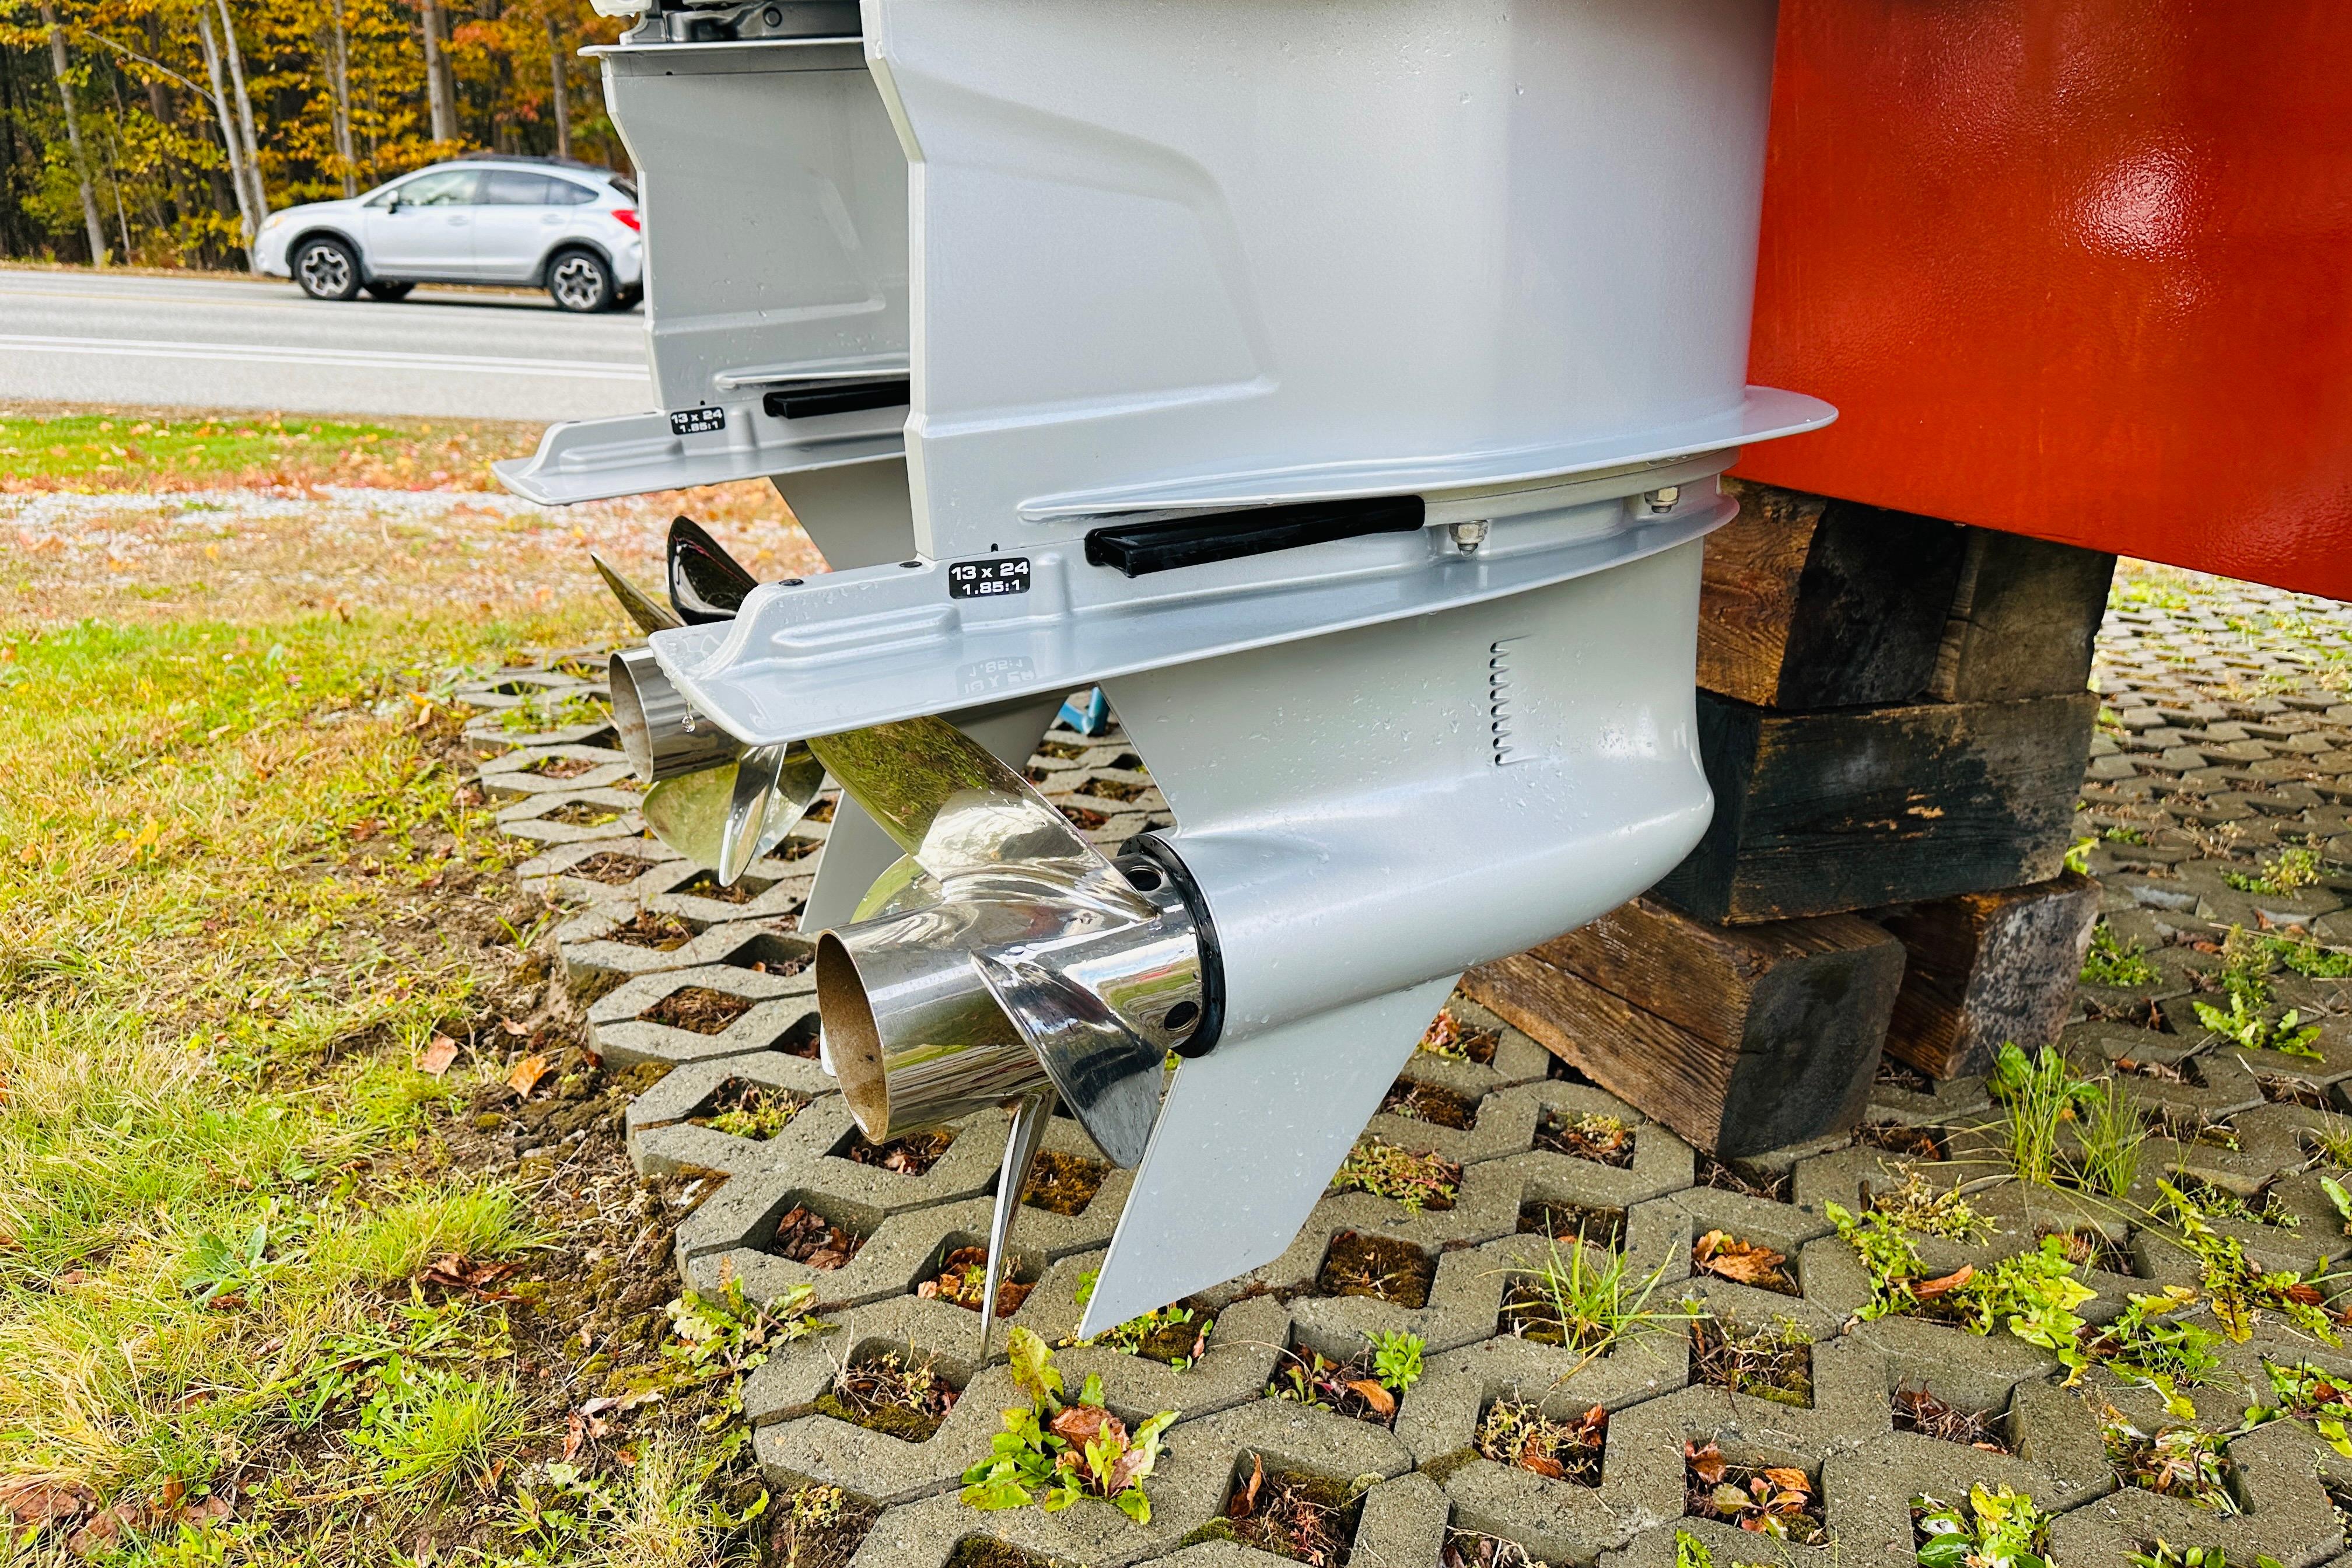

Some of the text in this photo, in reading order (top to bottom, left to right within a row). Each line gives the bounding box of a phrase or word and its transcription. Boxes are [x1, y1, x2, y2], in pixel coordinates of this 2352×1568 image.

[671, 413, 688, 424] 13
[702, 409, 722, 420] 24
[951, 561, 1029, 580] 13 x 24
[963, 579, 1020, 595] 1.85:1
